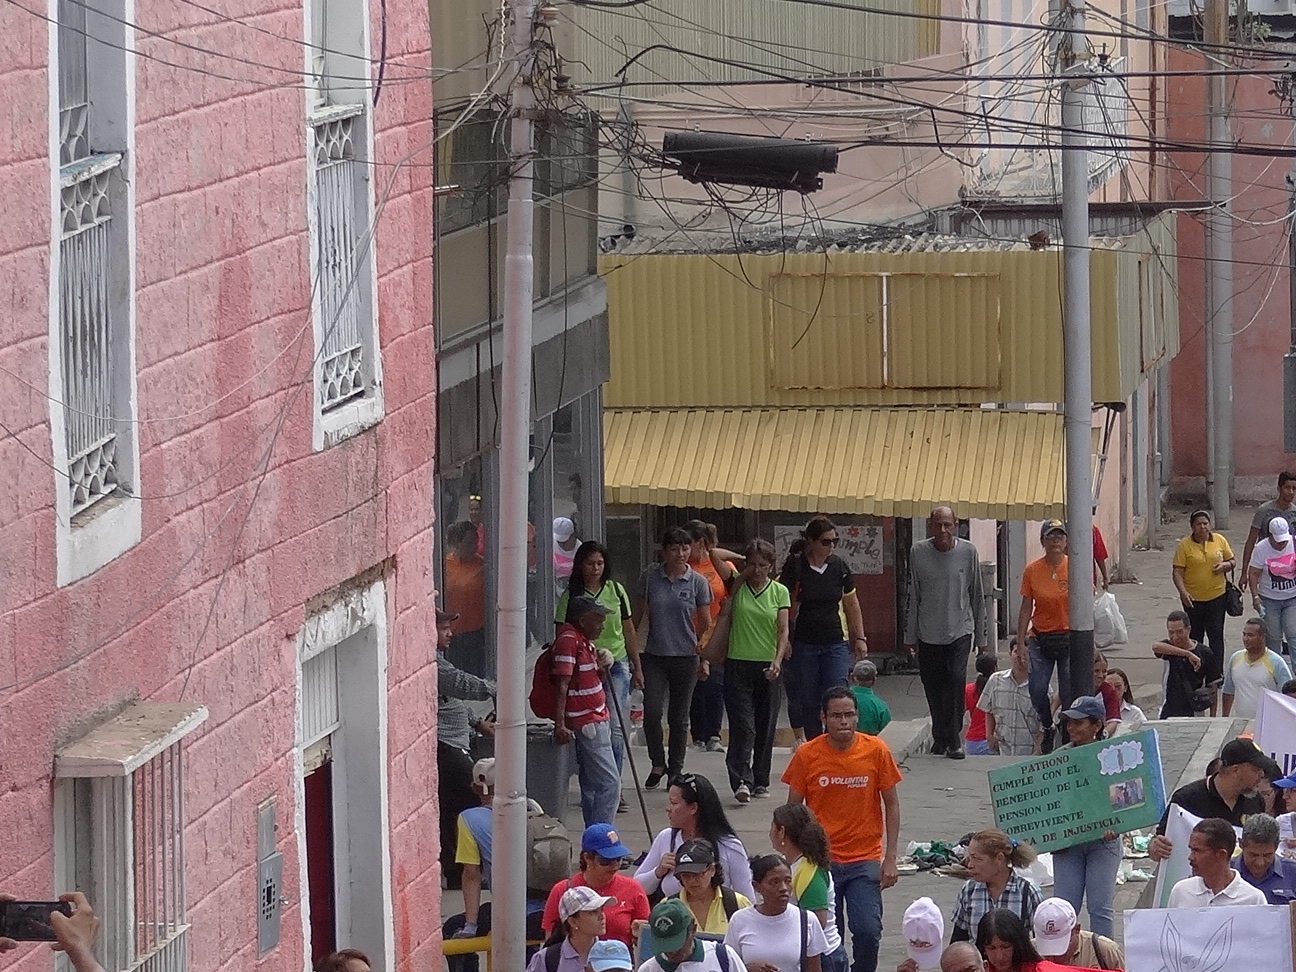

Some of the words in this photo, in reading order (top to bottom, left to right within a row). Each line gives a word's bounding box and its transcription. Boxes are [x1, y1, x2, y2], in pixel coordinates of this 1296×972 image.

[1020, 755, 1070, 774] PATRONO
[831, 776, 869, 785] VOLUNTAD
[993, 776, 1034, 793] CUMPLE
[1042, 770, 1062, 781] CON
[1067, 765, 1081, 775] EL
[996, 788, 1050, 808] BENEFICIO
[1056, 783, 1071, 793] DE
[1076, 777, 1090, 787] LA
[998, 807, 1046, 823] PENSION
[1047, 800, 1061, 811] DE
[1042, 832, 1057, 844] DE
